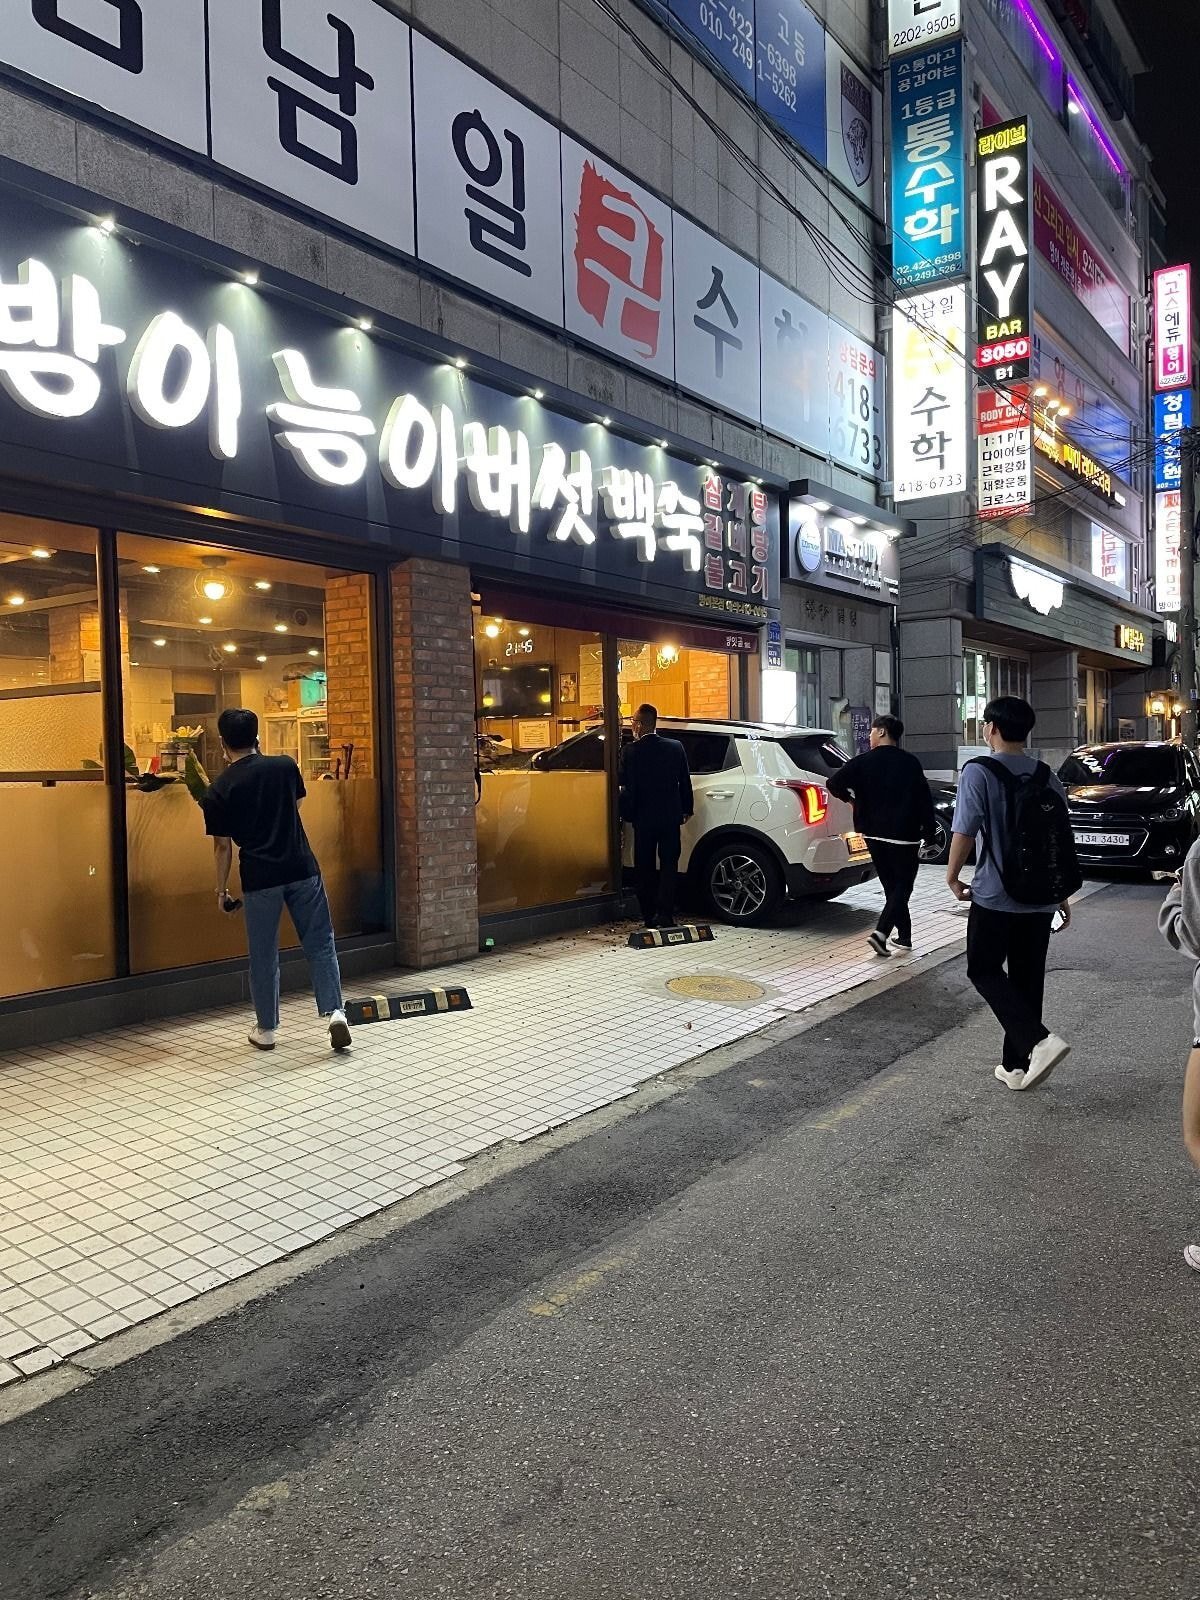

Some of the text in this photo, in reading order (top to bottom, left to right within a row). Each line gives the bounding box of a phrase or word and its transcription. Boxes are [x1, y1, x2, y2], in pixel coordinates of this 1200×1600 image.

[893, 13, 956, 47] 2202-9505
[700, 2, 797, 113] 010-2491-5262
[897, 65, 957, 93] 공감하는
[901, 88, 957, 120] 1등급
[979, 124, 1027, 156] 라이브
[903, 113, 960, 245] 통수학
[980, 156, 1028, 319] RAY
[896, 262, 963, 286] 010.2491.5262
[1164, 280, 1181, 343] 고스에듀
[986, 319, 1022, 341] BAR
[838, 342, 877, 383] 상담문의
[995, 365, 1014, 381] B1
[1166, 346, 1181, 373] 영어
[910, 386, 953, 471] 수학
[980, 407, 1004, 423] BODY
[833, 420, 882, 471] 6733
[983, 430, 1025, 447] 1:1 PT
[982, 460, 1026, 477] 근력강화
[898, 473, 962, 493] 418-6733
[983, 475, 1027, 492] 재활운동
[703, 552, 769, 600] 불고기
[506, 639, 533, 657] 21:45
[1100, 835, 1126, 844] 3430
